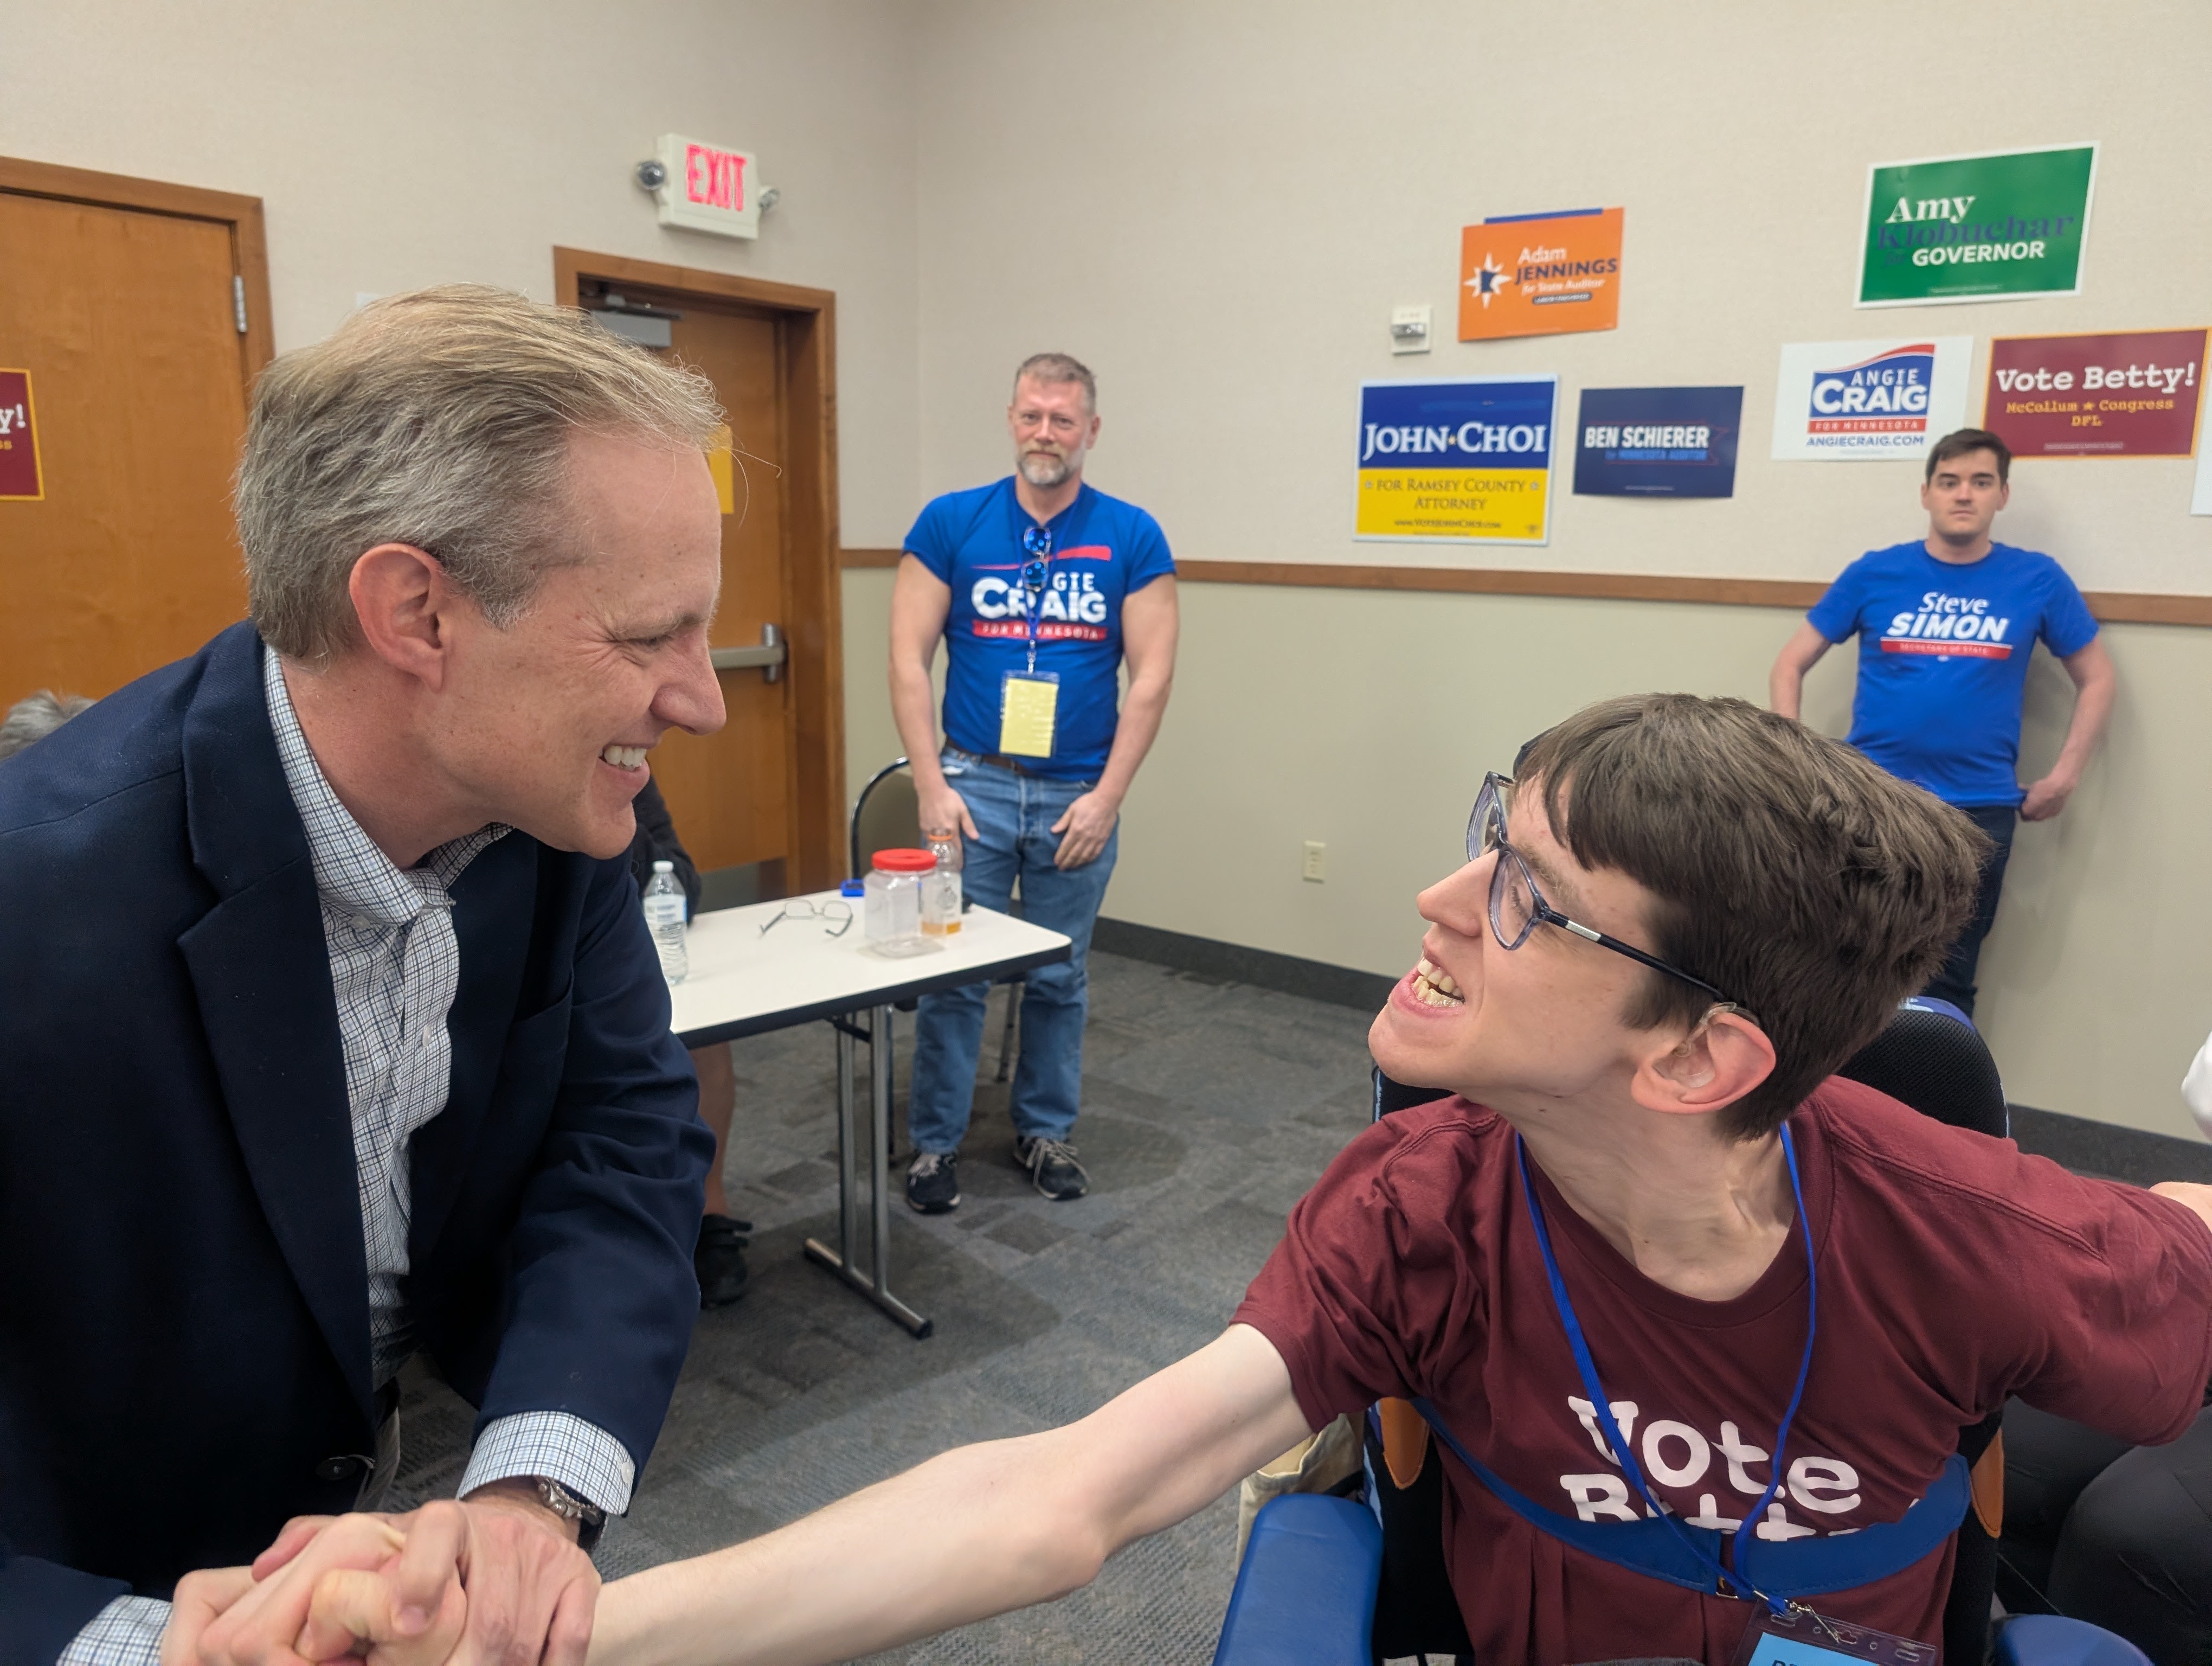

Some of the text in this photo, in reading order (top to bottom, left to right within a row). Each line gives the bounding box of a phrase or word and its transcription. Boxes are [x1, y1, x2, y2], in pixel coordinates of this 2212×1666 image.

[687, 144, 747, 211] EXIT
[1886, 195, 1976, 223] Amy
[1877, 215, 2074, 250] Klobuchar
[1517, 246, 1567, 265] Adam
[1912, 241, 2045, 266] GOVERNOR
[1514, 258, 1617, 285] JENNINGS
[1851, 368, 1919, 387] ANGIE
[1996, 362, 2196, 393] Vote Betty!
[1812, 379, 1927, 414] CRAIG
[2006, 400, 2175, 413] McCollum Congress
[1815, 420, 1918, 431] FOR MINNESOTA
[2071, 415, 2102, 427] DFL
[1362, 421, 1547, 460] JOHN CHOI
[1584, 426, 1709, 448] BEN SCHIERER
[1806, 436, 1924, 447] ANGIECRAIG.COM
[1377, 477, 1525, 492] FOR RAMSEY COUNTY
[1414, 496, 1487, 510] ATTORNEY
[971, 576, 1107, 623] CRAIG
[1918, 591, 1990, 614] Steve
[982, 623, 1008, 635] FOR
[1886, 612, 2009, 642] SIMON
[1567, 1395, 1861, 1514] Vote
